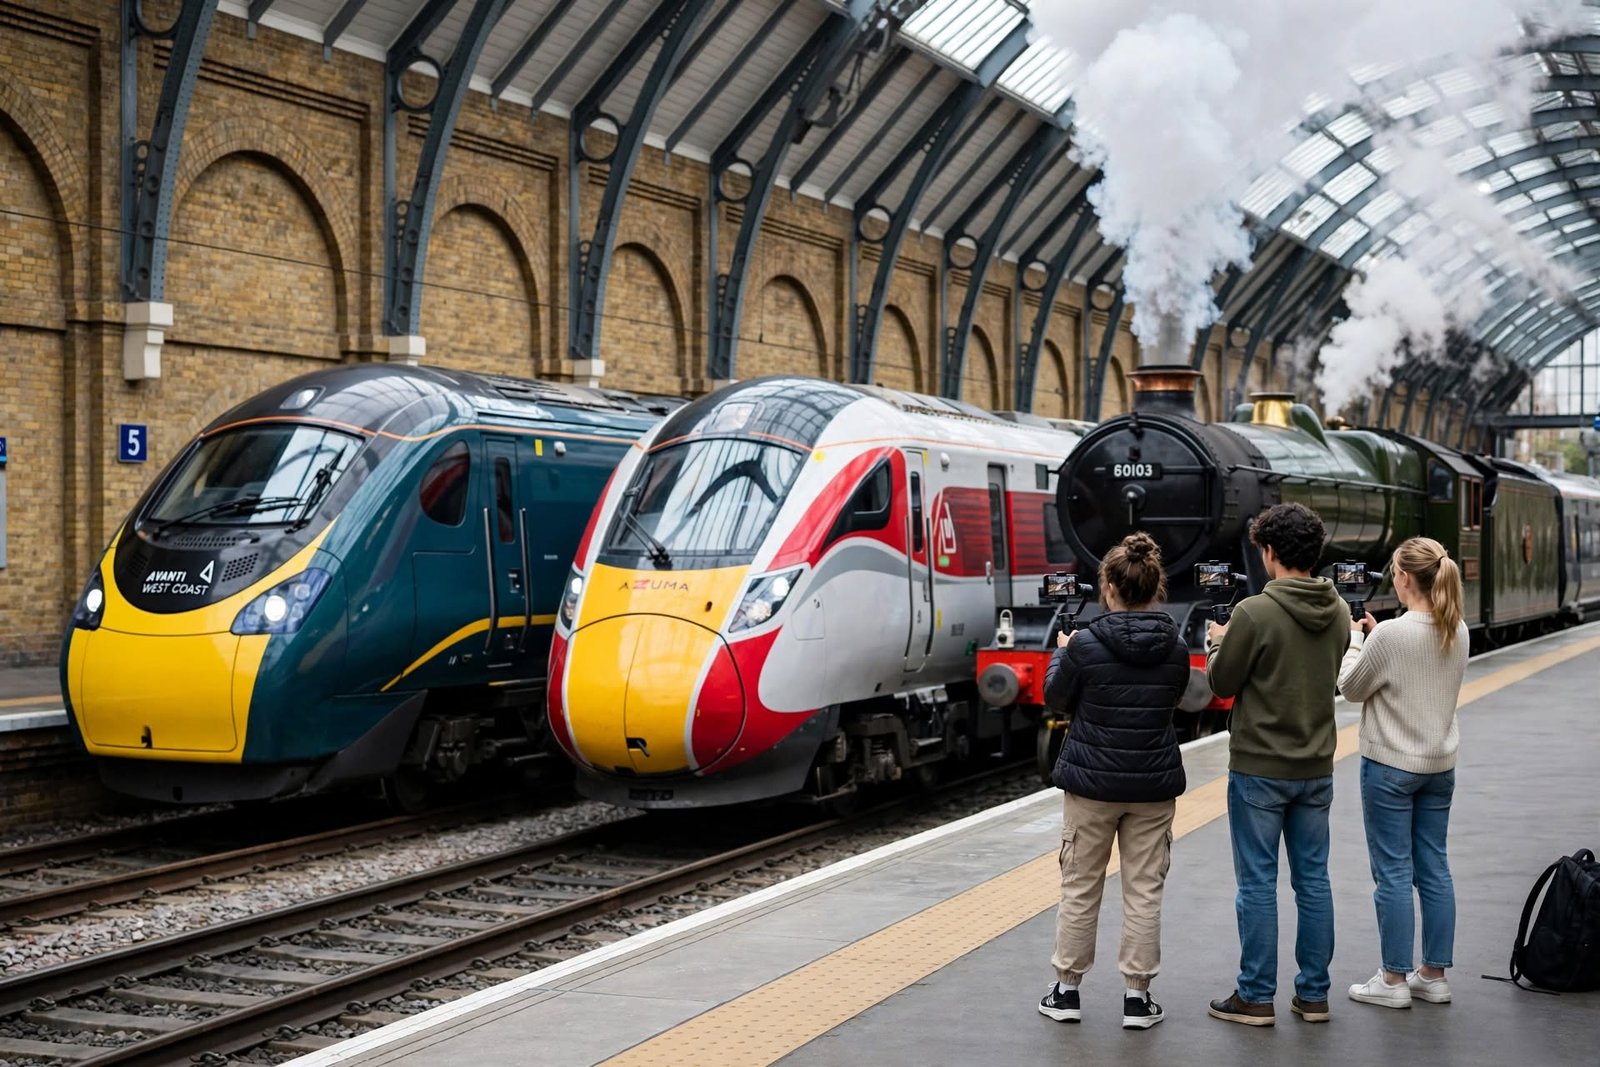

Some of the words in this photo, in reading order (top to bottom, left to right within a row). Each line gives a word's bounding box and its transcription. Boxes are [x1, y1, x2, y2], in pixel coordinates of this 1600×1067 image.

[128, 429, 140, 456] 5
[1114, 464, 1153, 477] 60103
[145, 571, 187, 582] AVANTI
[142, 583, 171, 593] WEST
[171, 584, 209, 595] COAST
[618, 579, 688, 591] AZUMA
